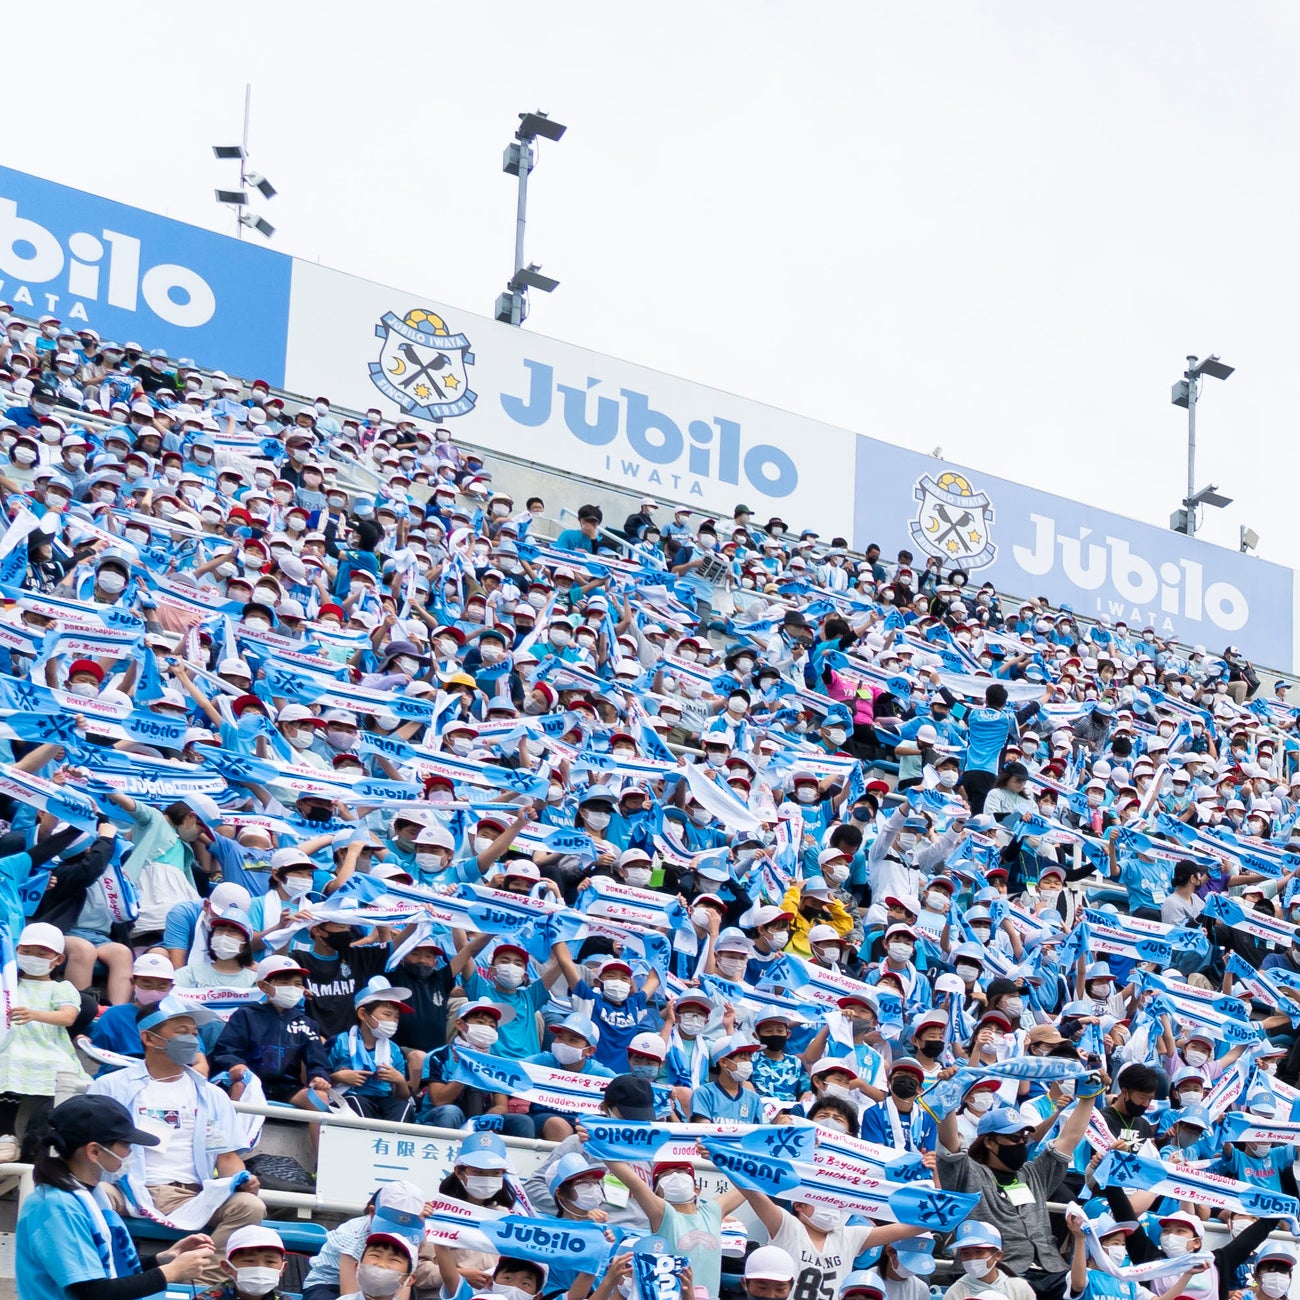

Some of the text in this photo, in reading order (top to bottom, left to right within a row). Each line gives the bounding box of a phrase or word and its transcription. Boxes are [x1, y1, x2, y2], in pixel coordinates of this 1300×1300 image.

[0, 280, 89, 322] ATA
[500, 358, 799, 498] Júbilo
[605, 455, 705, 497] IWATA
[1012, 513, 1249, 631] Júbilo
[1097, 598, 1174, 632] IWATA
[130, 719, 180, 739] Júbilo
[594, 1126, 660, 1146] Júbilo
[713, 1151, 788, 1185] Júbilo
[1249, 1196, 1298, 1215] Júbil
[497, 1222, 586, 1253] Júbilo
